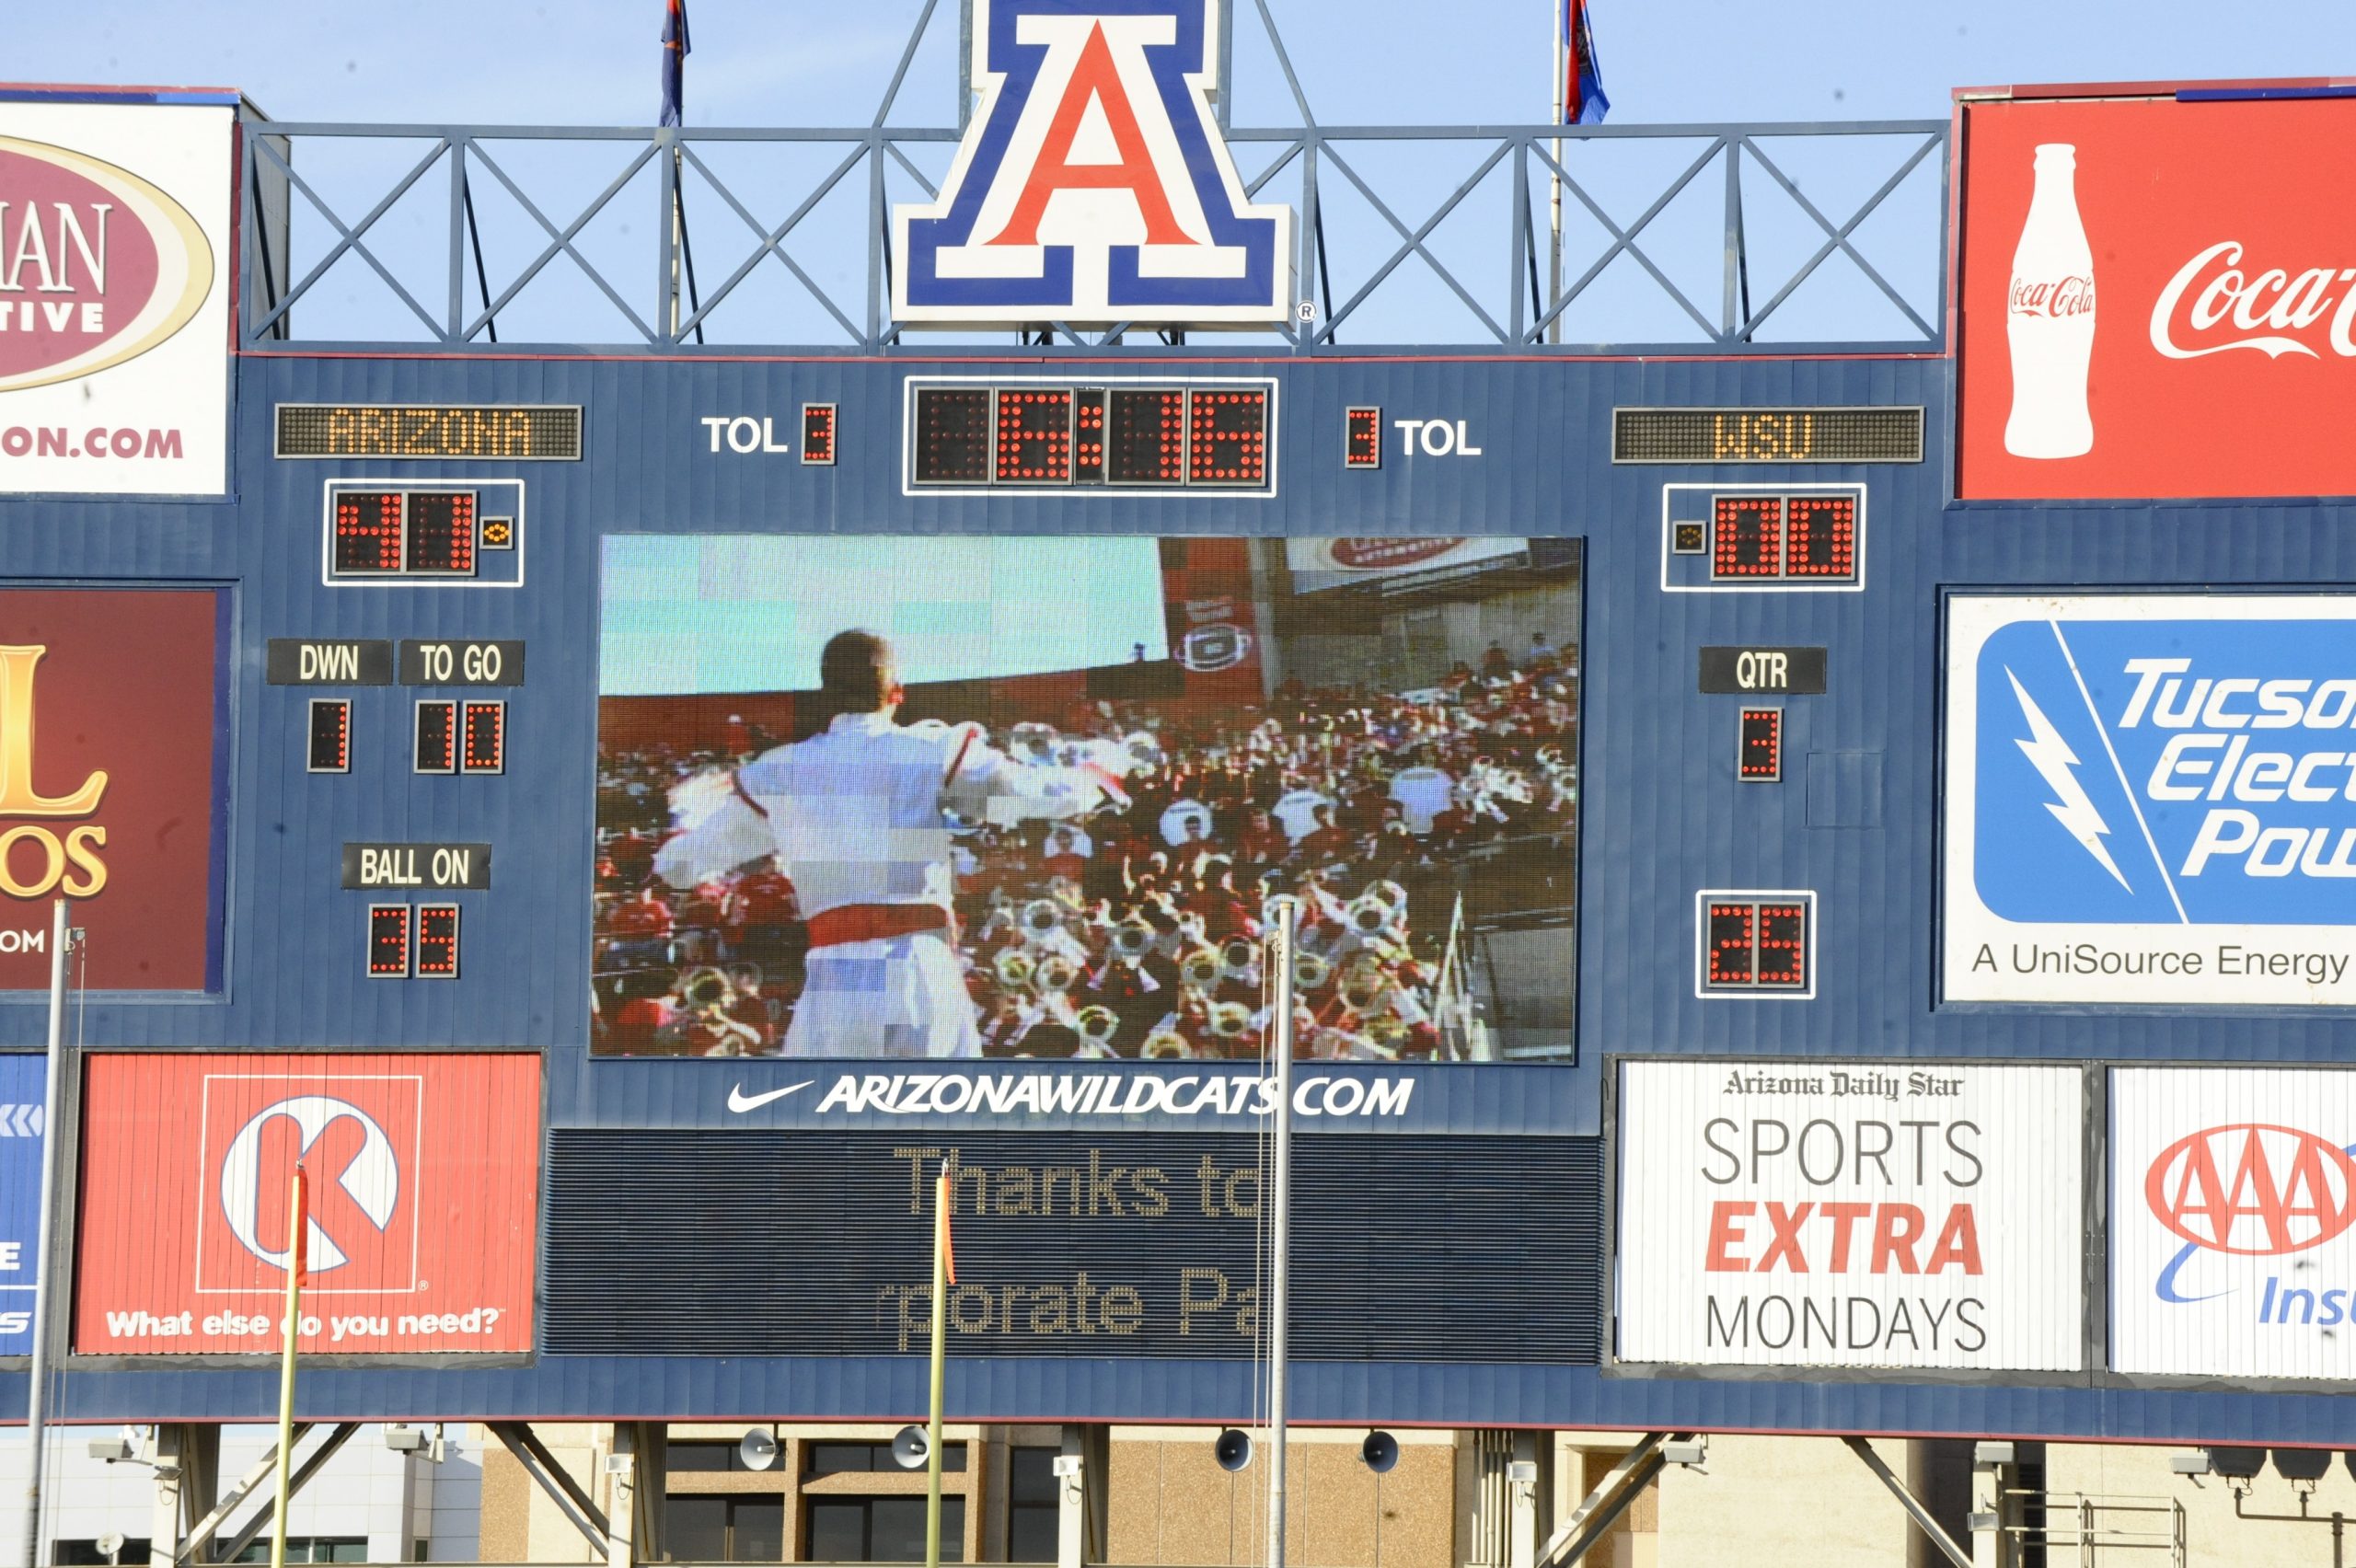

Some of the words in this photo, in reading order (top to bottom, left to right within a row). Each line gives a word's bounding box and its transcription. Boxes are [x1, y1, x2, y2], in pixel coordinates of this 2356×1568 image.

[893, 0, 1290, 322] A
[2011, 276, 2094, 317] Coca-Cola
[2, 426, 184, 459] ON.COM
[329, 409, 531, 455] ARIZONA
[702, 417, 788, 454] TOL
[805, 409, 833, 460] 3
[999, 392, 1265, 478] 6:16
[1348, 410, 1378, 463] 3
[1394, 420, 1482, 456] TOL
[1715, 414, 1813, 459] WSU
[338, 494, 473, 570] 41
[1715, 500, 1854, 575] 00
[300, 644, 358, 681] DWN
[420, 644, 453, 681] TO
[463, 644, 502, 682] GO
[1736, 651, 1788, 689] QTR
[2118, 658, 2356, 729] Tucso
[445, 705, 502, 767] 10
[1742, 711, 1778, 775] 3
[361, 848, 422, 884] BALL
[432, 848, 469, 885] ON
[372, 908, 456, 973] 35
[1709, 905, 1802, 983] 25
[1971, 943, 1998, 973] A
[2013, 942, 2203, 975] UniSource
[2218, 945, 2350, 985] Energy
[815, 1074, 1415, 1116] ARIZONAWILDCATSCOM
[1723, 1069, 1825, 1095] Arizona
[1830, 1070, 1900, 1102] Daily
[1907, 1071, 1965, 1097] Star
[1701, 1117, 1983, 1188] SPORTS
[893, 1147, 1170, 1216] Thanks
[2163, 1124, 2347, 1255] AAA
[1704, 1201, 1983, 1275] EXTRA
[106, 1310, 193, 1338] What
[202, 1309, 271, 1335] else
[330, 1315, 389, 1342] you
[398, 1307, 499, 1335] need?
[1706, 1295, 1986, 1352] MONDAYS
[2258, 1276, 2356, 1325] Ins
